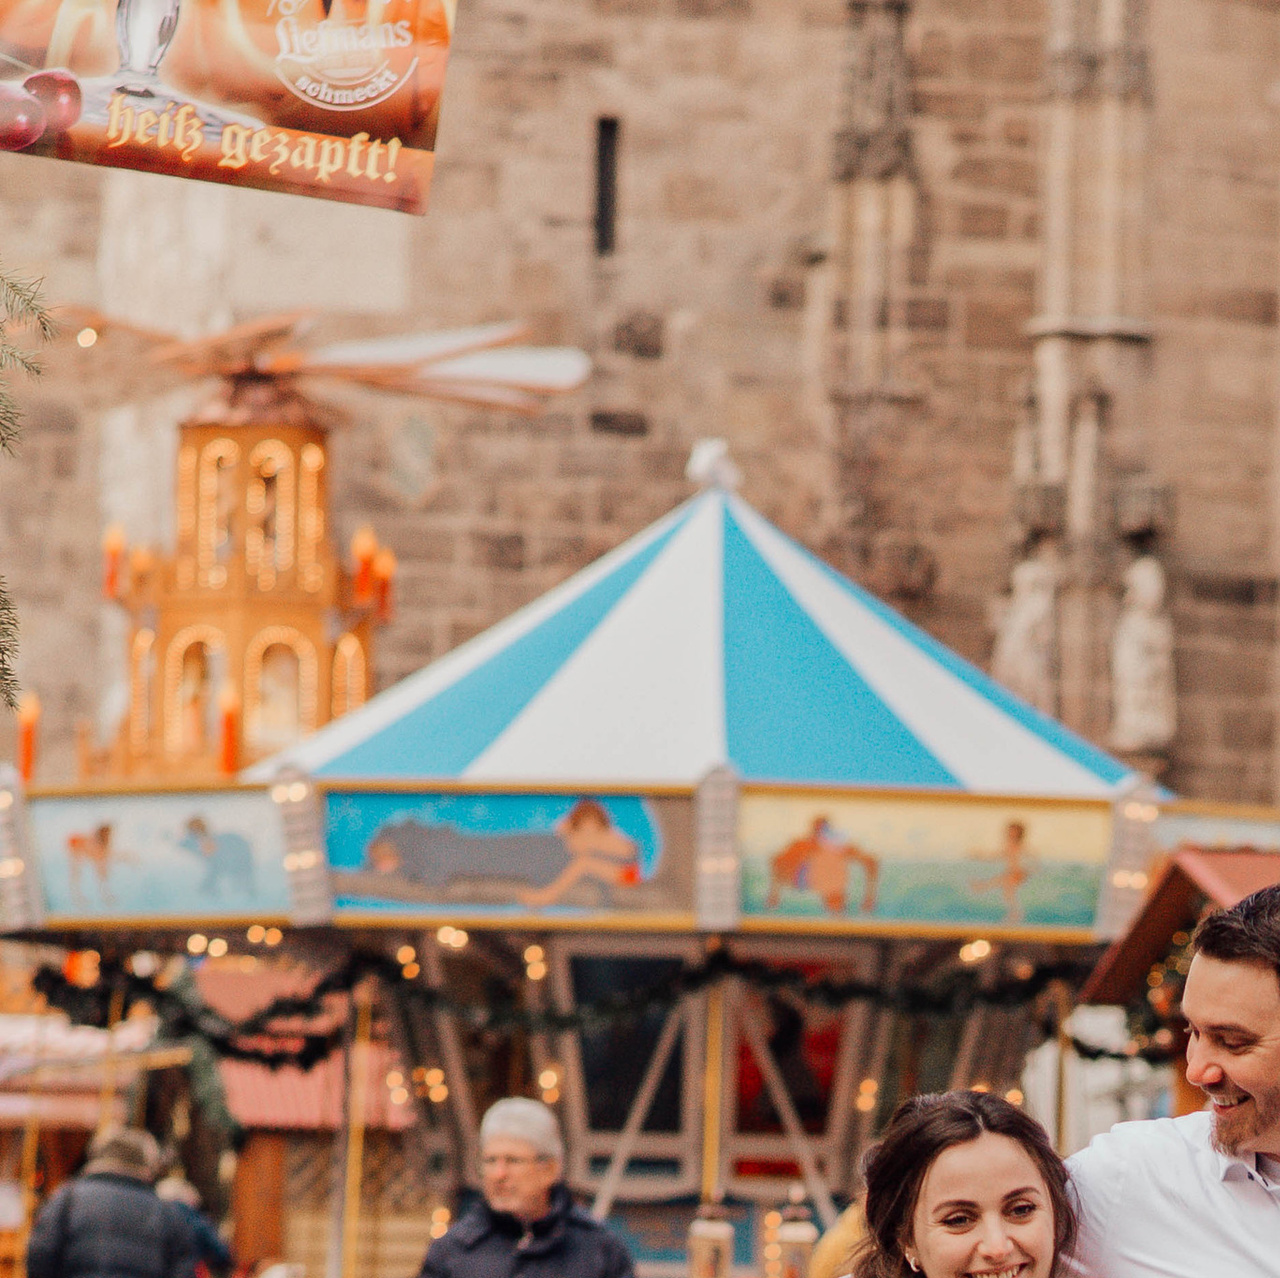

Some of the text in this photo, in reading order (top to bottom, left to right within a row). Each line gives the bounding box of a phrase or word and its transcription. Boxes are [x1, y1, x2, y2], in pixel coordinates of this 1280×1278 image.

[275, 16, 414, 63] Liefmans
[296, 69, 399, 104] schmeckt
[106, 92, 402, 183] heiß gezapft!
